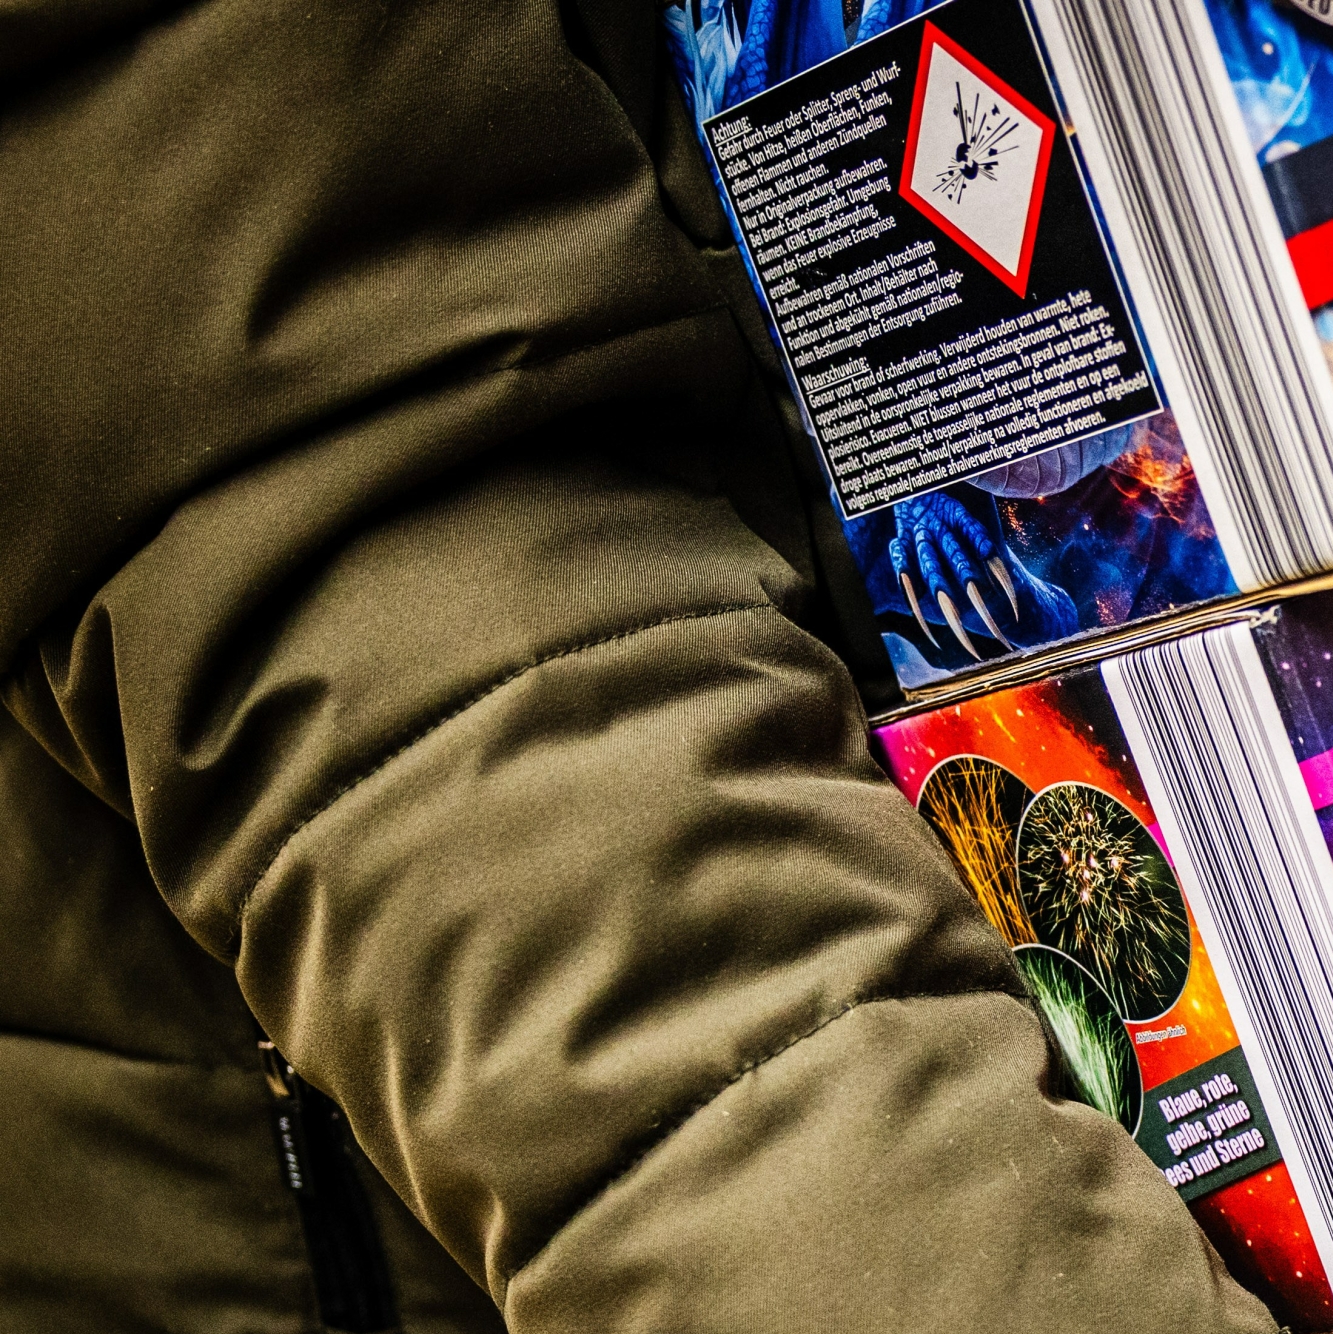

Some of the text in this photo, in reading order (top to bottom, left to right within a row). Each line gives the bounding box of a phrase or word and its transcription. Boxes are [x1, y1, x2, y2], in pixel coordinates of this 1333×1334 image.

[710, 114, 753, 147] Achtung:
[716, 59, 902, 162] Gefahr durch Feuer oder Splitter, Spreng- und Wurf-
[723, 90, 894, 180] stücke. Von Hitze, heißen Oberflächen, Funken,
[730, 113, 888, 198] offenen Flammen und anderen Zündquellen
[799, 355, 872, 395] Waarschuwing:
[807, 288, 1093, 410] Gevaar voor brand of scherfwerking. Verwijderd houden van warmte, hete
[1158, 1073, 1239, 1123] Blaue, rote,
[1166, 1100, 1251, 1156] gelbe, grüne
[1161, 1127, 1266, 1188] ees und Sterne
